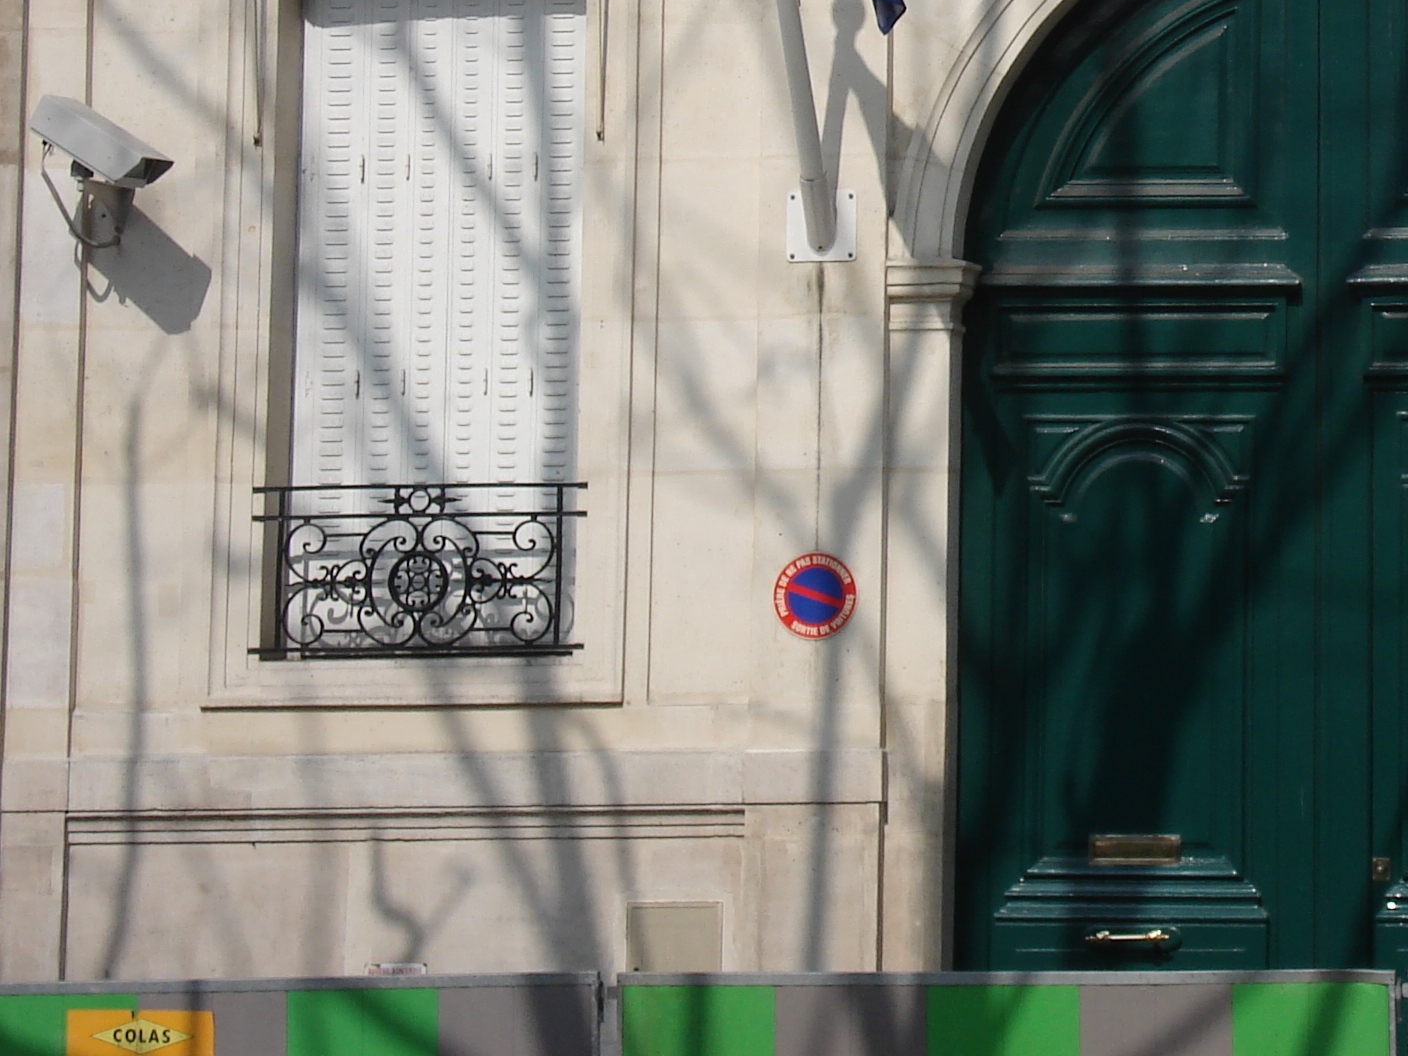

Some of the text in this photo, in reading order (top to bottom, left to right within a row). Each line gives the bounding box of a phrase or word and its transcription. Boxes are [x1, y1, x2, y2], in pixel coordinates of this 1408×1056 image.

[778, 574, 790, 588] DE
[796, 556, 811, 569] PAS
[791, 620, 818, 636] SORTIE
[113, 1028, 171, 1044] COLAS
